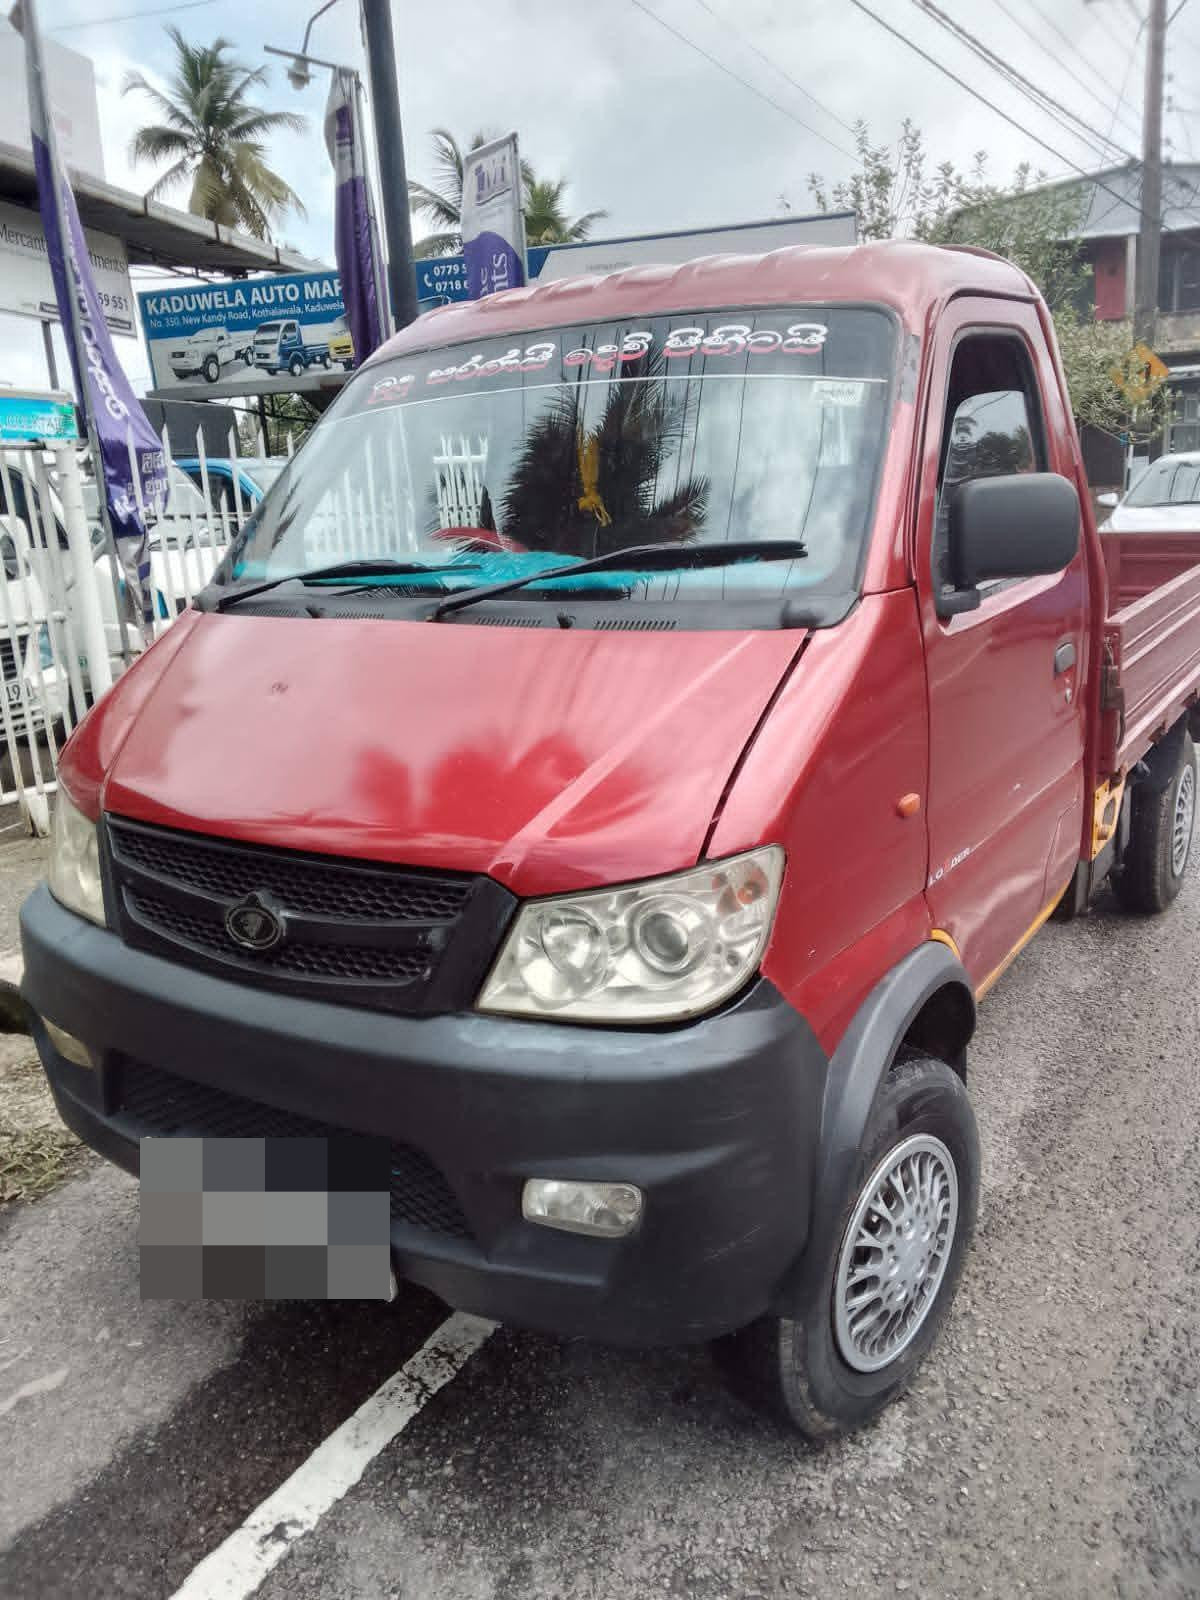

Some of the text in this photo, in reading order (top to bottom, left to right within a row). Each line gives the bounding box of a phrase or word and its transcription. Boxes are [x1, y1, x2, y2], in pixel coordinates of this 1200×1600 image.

[433, 264, 460, 276] 0779
[435, 280, 461, 292] 0718
[146, 289, 247, 316] KADUWELA
[251, 284, 299, 305] AUTO
[182, 314, 201, 325] New
[202, 311, 226, 324] Kandy
[228, 310, 251, 321] Road,
[662, 323, 828, 357] පිහිටයි
